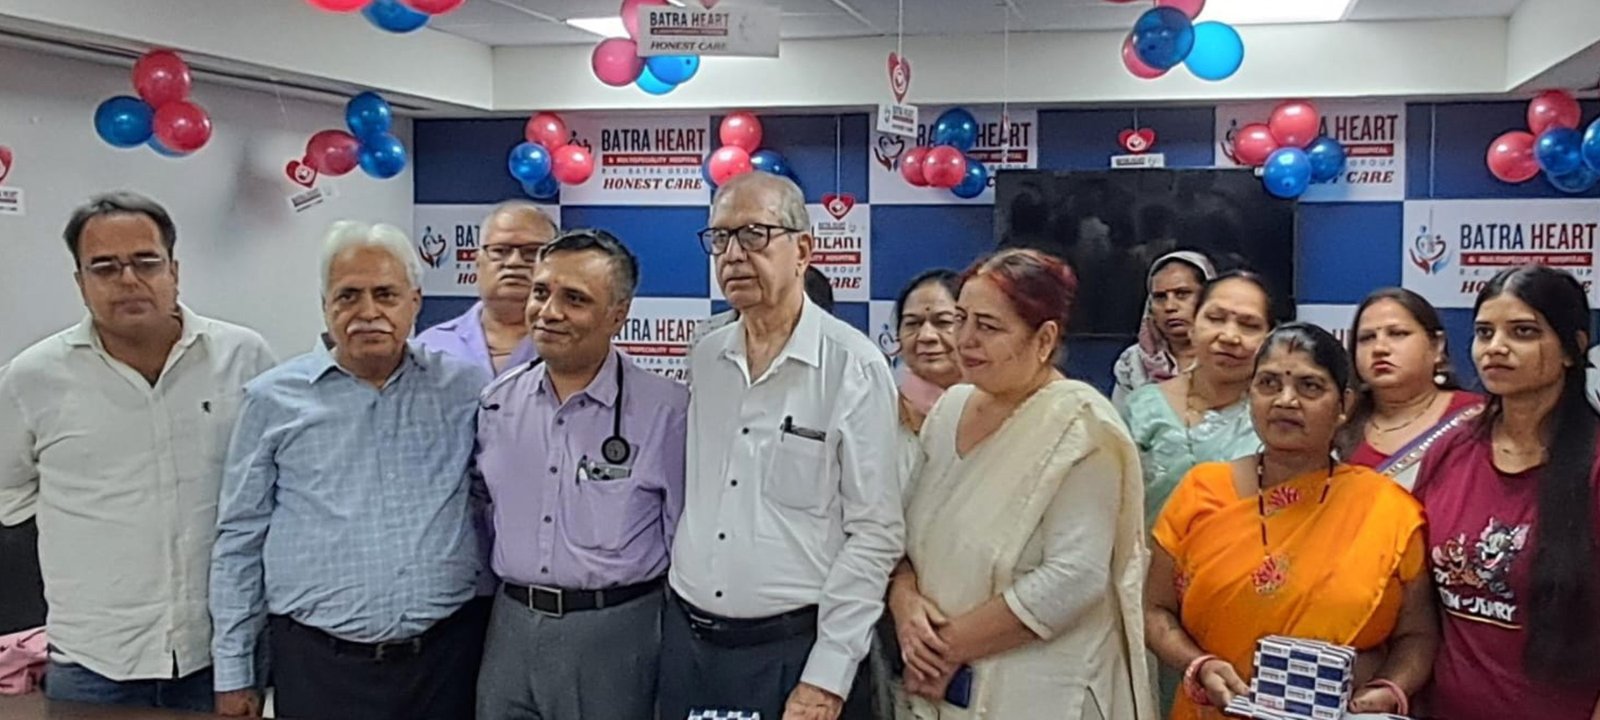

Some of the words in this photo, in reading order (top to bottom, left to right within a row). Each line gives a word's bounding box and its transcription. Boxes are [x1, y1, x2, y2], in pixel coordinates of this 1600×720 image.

[650, 12, 688, 26] BATRA
[691, 13, 729, 27] HEART
[650, 41, 696, 50] HONEST
[976, 122, 1031, 147] HEART
[1335, 115, 1398, 140] HEART
[601, 129, 649, 151] BATRA
[655, 129, 705, 151] HEART
[603, 178, 662, 189] HONEST
[664, 178, 703, 189] CARE
[1346, 171, 1394, 183] CARE
[456, 225, 480, 247] BAT
[1461, 224, 1524, 249] BATRA
[1531, 224, 1598, 249] HEART
[832, 277, 861, 288] ARE
[613, 318, 651, 340] TRA
[656, 319, 700, 341] HEAR
